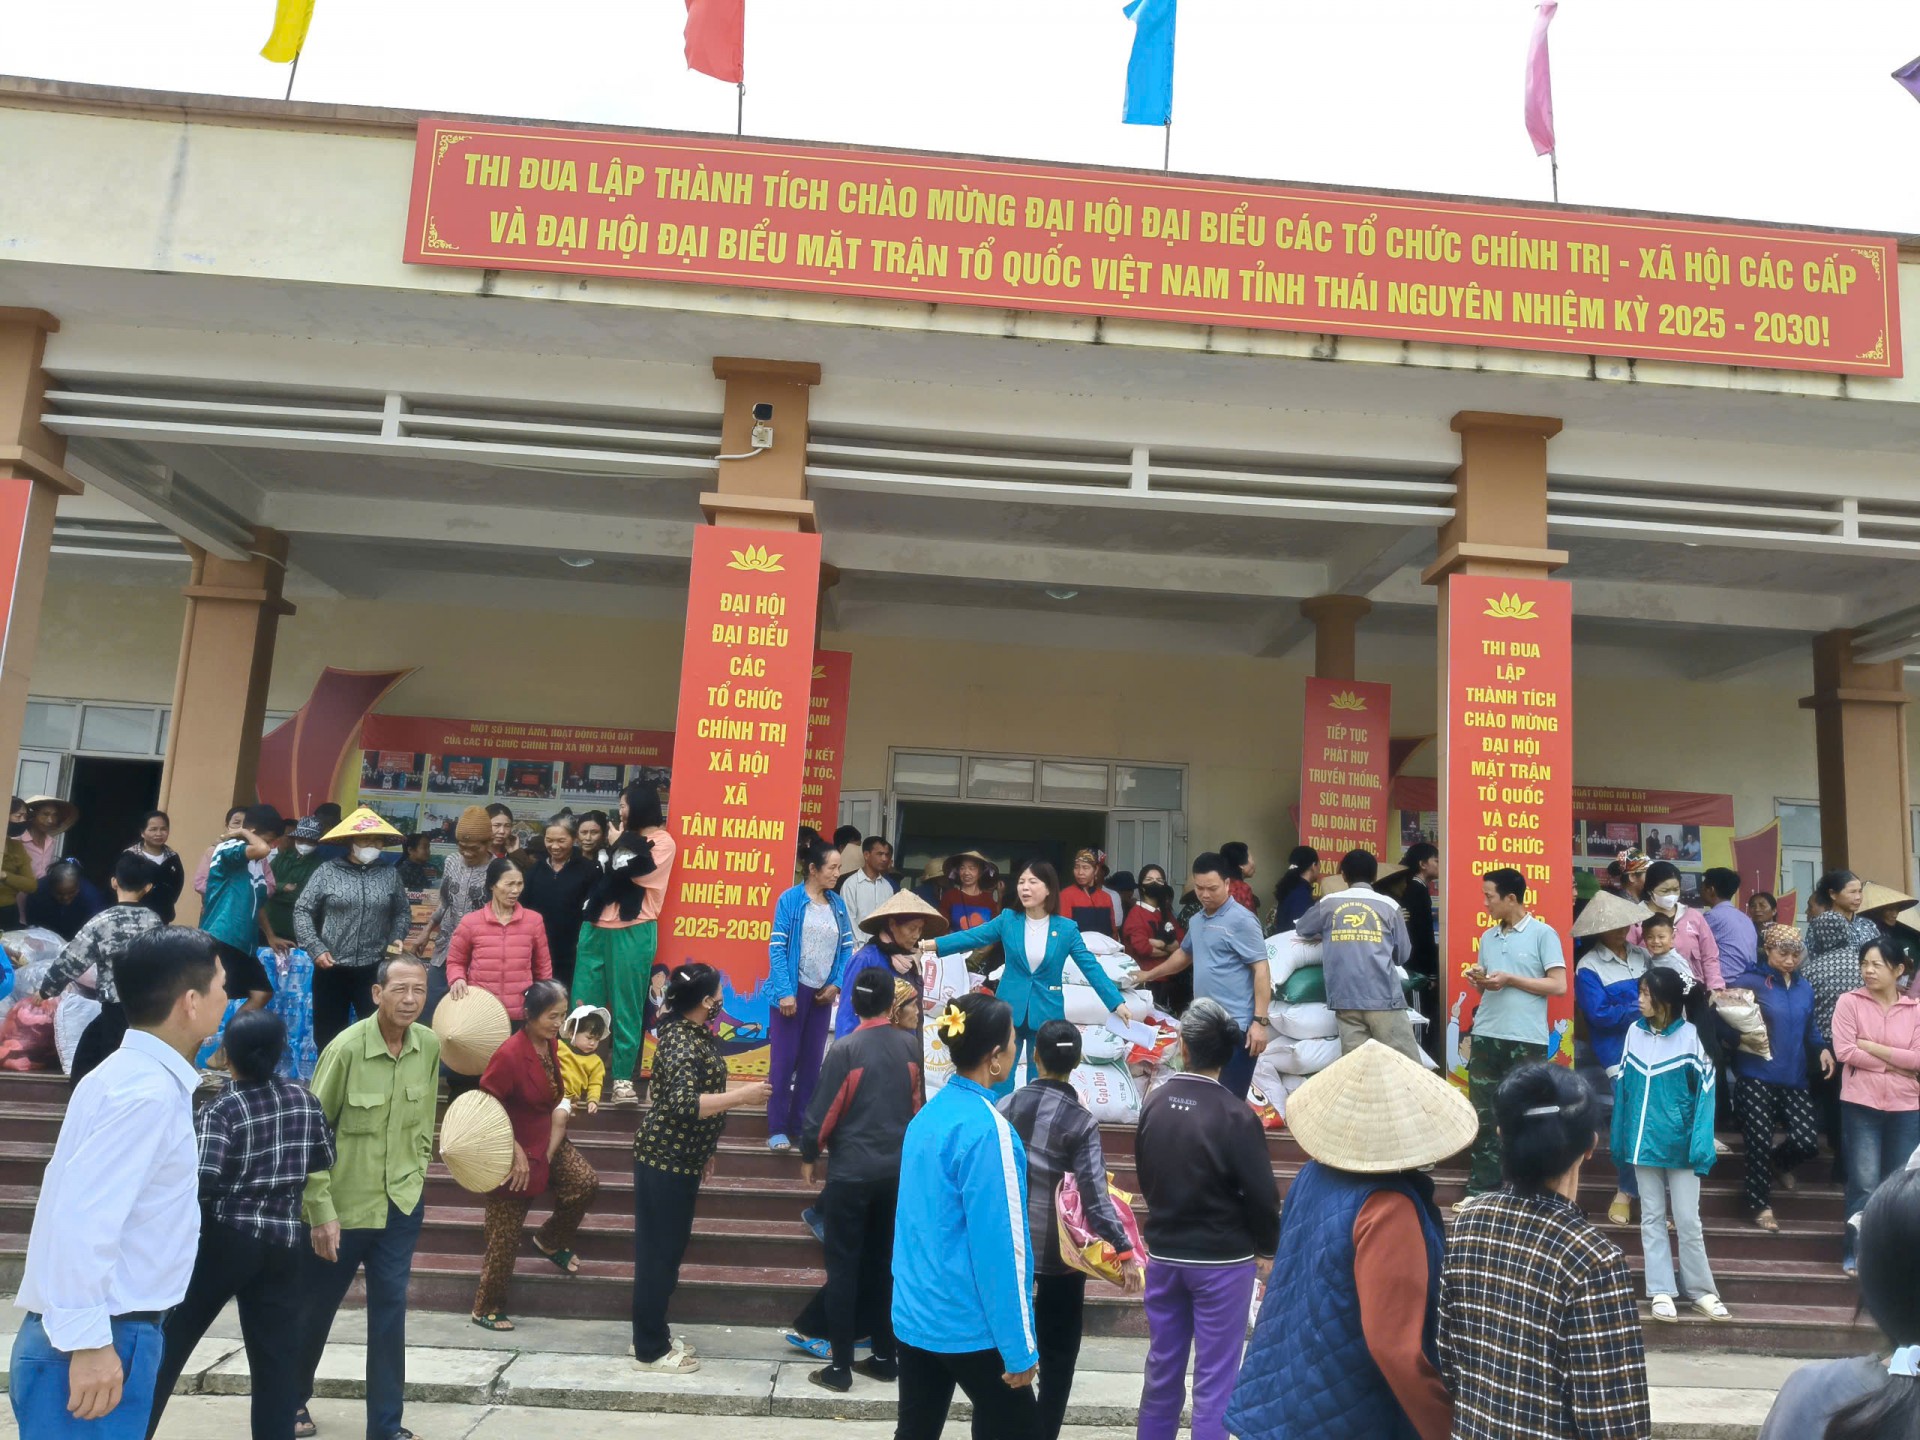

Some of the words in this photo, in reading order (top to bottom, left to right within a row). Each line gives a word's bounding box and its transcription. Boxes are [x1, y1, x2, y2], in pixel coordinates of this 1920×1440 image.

[465, 154, 510, 187] THI
[518, 157, 577, 192] ĐUA
[587, 157, 644, 202] LẬP
[655, 164, 753, 205] THÀNH
[763, 170, 828, 211] TÍCH
[838, 176, 917, 218] CHÀO
[927, 185, 1015, 227] MỪNG
[1025, 197, 1073, 237] ĐẠI
[1084, 197, 1132, 243] HỘI
[1142, 206, 1190, 247] ĐẠI
[1200, 201, 1265, 247] BIỂU
[1275, 212, 1332, 253] CÁC
[1342, 212, 1378, 256] TỔ
[1386, 223, 1461, 263] CHỨC
[1471, 230, 1558, 271] CHÍNH
[1567, 241, 1609, 283] TRỊ
[1639, 244, 1677, 282] XÃ
[1685, 247, 1730, 291] HỘI
[1739, 250, 1794, 290] CÁC
[1803, 253, 1857, 295] CẤP
[489, 211, 527, 245] VÀ
[536, 216, 586, 256] ĐẠI
[597, 213, 647, 260] HỘI
[657, 223, 707, 264] ĐẠI
[718, 217, 786, 264] BIỂU
[796, 230, 858, 276] MẶT
[870, 236, 948, 282] TRẬN
[958, 236, 995, 281] TỔ
[1002, 244, 1081, 288] QUỐC
[1091, 254, 1153, 299] VIỆT
[1161, 263, 1229, 300] NAM
[1239, 260, 1305, 305] TỈNH
[1314, 272, 1379, 310] THÁI
[1388, 282, 1502, 320] NGUYÊN
[1512, 289, 1605, 334] NHIỆM
[1614, 294, 1648, 333] KỲ
[1658, 303, 1725, 339] 2025
[1753, 312, 1830, 347] 2030!
[720, 593, 750, 617] ĐẠI
[755, 592, 785, 618] HỘI
[712, 624, 742, 648] ĐẠI
[748, 620, 789, 648] BIỂU
[1482, 640, 1506, 657] THI
[1510, 642, 1541, 659] ĐUA
[729, 656, 765, 678] CÁC
[1496, 664, 1526, 684] LẬP
[707, 681, 730, 708] TỔ
[735, 686, 783, 711] CHỨC
[1466, 686, 1518, 706] THÀNH
[1522, 687, 1556, 707] TÍCH
[492, 723, 503, 734] SỐ
[505, 725, 525, 735] HÌNH
[697, 716, 753, 741] CHÍNH
[759, 723, 787, 747] TRỊ
[1464, 710, 1507, 729] CHÀO
[1511, 711, 1558, 732] MỪNG
[1326, 722, 1347, 739] TIẾP
[1351, 727, 1368, 745] TỤC
[444, 734, 461, 745] CỦA
[496, 738, 519, 748] CHỨC
[521, 739, 548, 750] CHÍNH
[565, 742, 577, 752] XÃ
[579, 743, 593, 753] HỘI
[596, 744, 608, 753] XÃ
[610, 745, 626, 754] TÂN
[628, 746, 658, 756] KHÁNH
[815, 746, 835, 761] KẾT
[1324, 745, 1348, 763] PHÁT
[1351, 750, 1370, 765] HUY
[1482, 737, 1509, 757] ĐẠI
[1514, 737, 1540, 758] HỘI
[708, 749, 733, 772] XÃ
[739, 752, 769, 777] HỘI
[1472, 759, 1505, 780] MẶT
[1510, 761, 1551, 783] TRẬN
[1309, 766, 1346, 785] TRUYỀN
[1348, 770, 1382, 790] THỐNG,
[723, 782, 748, 806] XÃ
[1319, 790, 1339, 807] SỨC
[1342, 794, 1371, 811] MẠNH
[1477, 781, 1498, 802] TỔ
[1502, 786, 1544, 805] QUỐC
[681, 814, 718, 837] TÂN
[722, 814, 784, 841] KHÁNH
[1312, 814, 1328, 831] ĐẠI
[1330, 814, 1357, 830] ĐOÀN
[1359, 814, 1378, 833] KẾT
[1482, 809, 1503, 827] VÀ
[1507, 809, 1540, 829] CÁC
[1308, 834, 1334, 852] TOÀN
[1336, 837, 1356, 853] DÂN
[1477, 831, 1498, 852] TỔ
[1502, 836, 1544, 855] CHỨC
[683, 843, 719, 871] LẦN
[725, 848, 761, 873] THỨ
[763, 854, 775, 876] I,
[1319, 857, 1338, 875] XÂY
[1526, 864, 1550, 883] TRỊ
[680, 881, 742, 907] NHIỆM
[747, 882, 771, 907] KỲ
[673, 916, 771, 941] 2025-2030
[1096, 1088, 1111, 1105] Gạo
